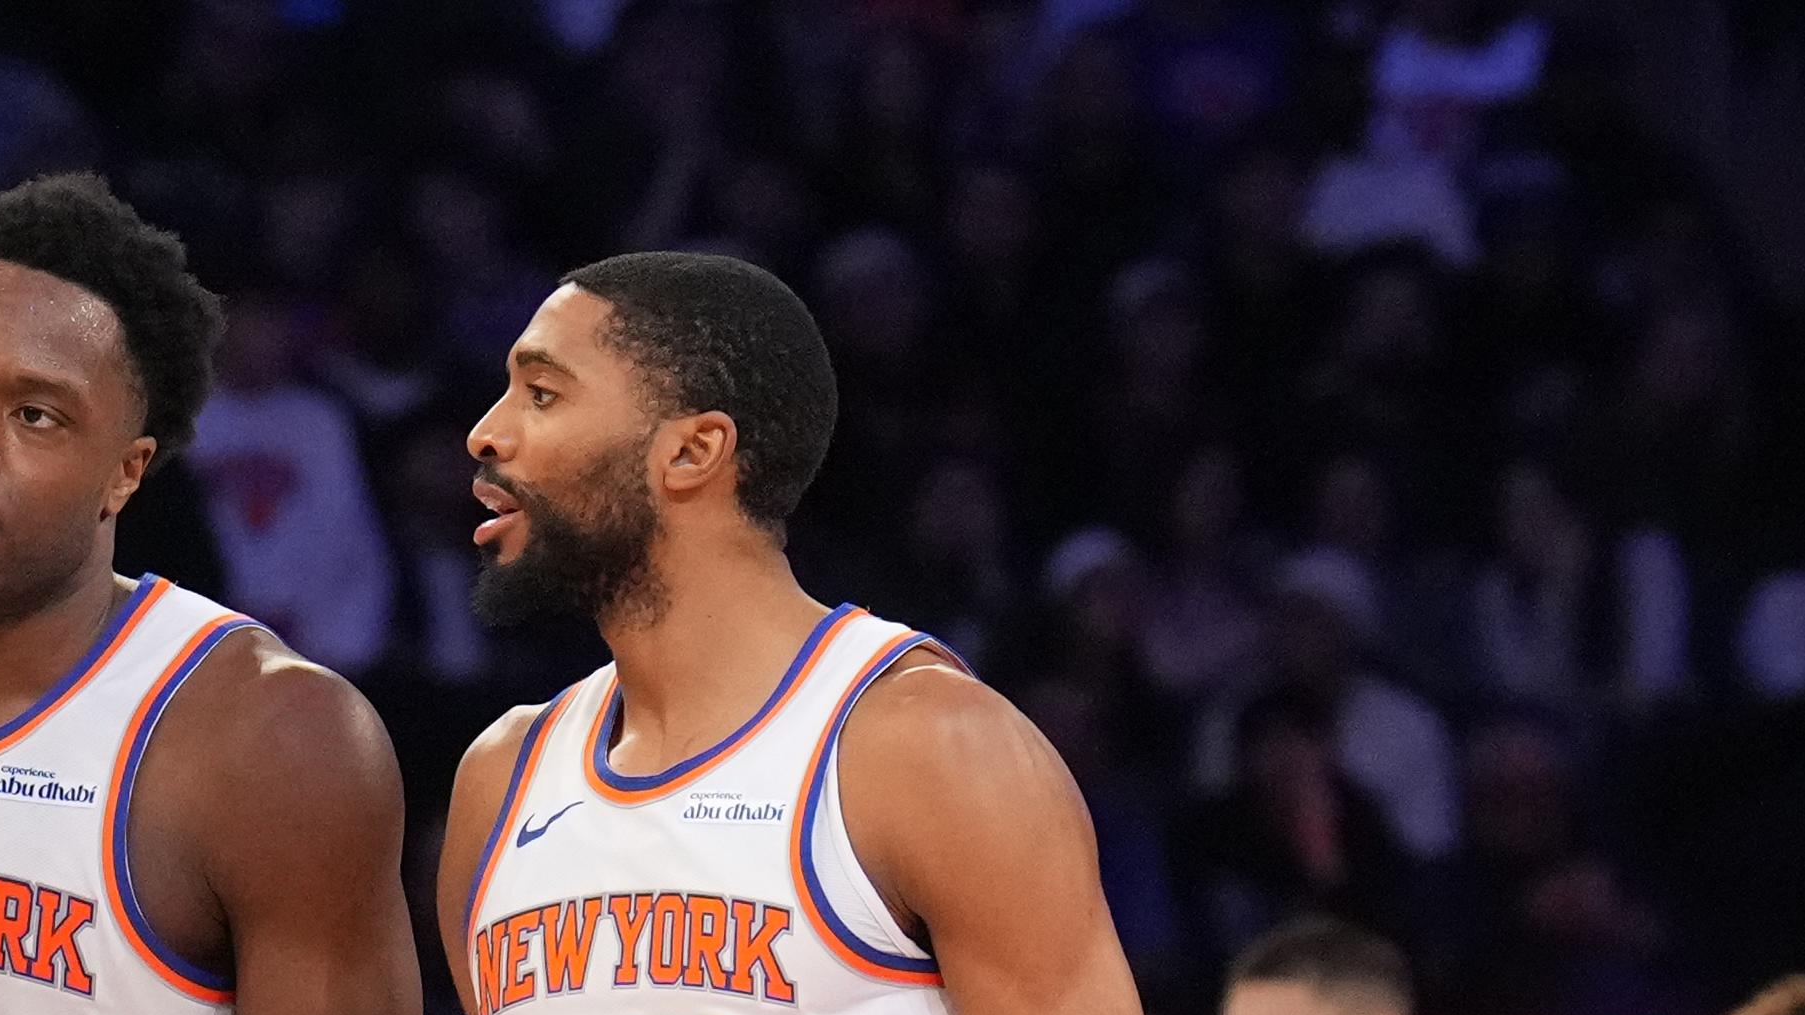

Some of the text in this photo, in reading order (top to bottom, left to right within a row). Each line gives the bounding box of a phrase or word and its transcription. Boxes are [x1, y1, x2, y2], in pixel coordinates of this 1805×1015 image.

[1, 765, 56, 778] experience
[38, 782, 98, 803] dhabi
[690, 792, 743, 801] experience
[683, 802, 786, 821] abu dhabi
[603, 890, 798, 1009] YORK
